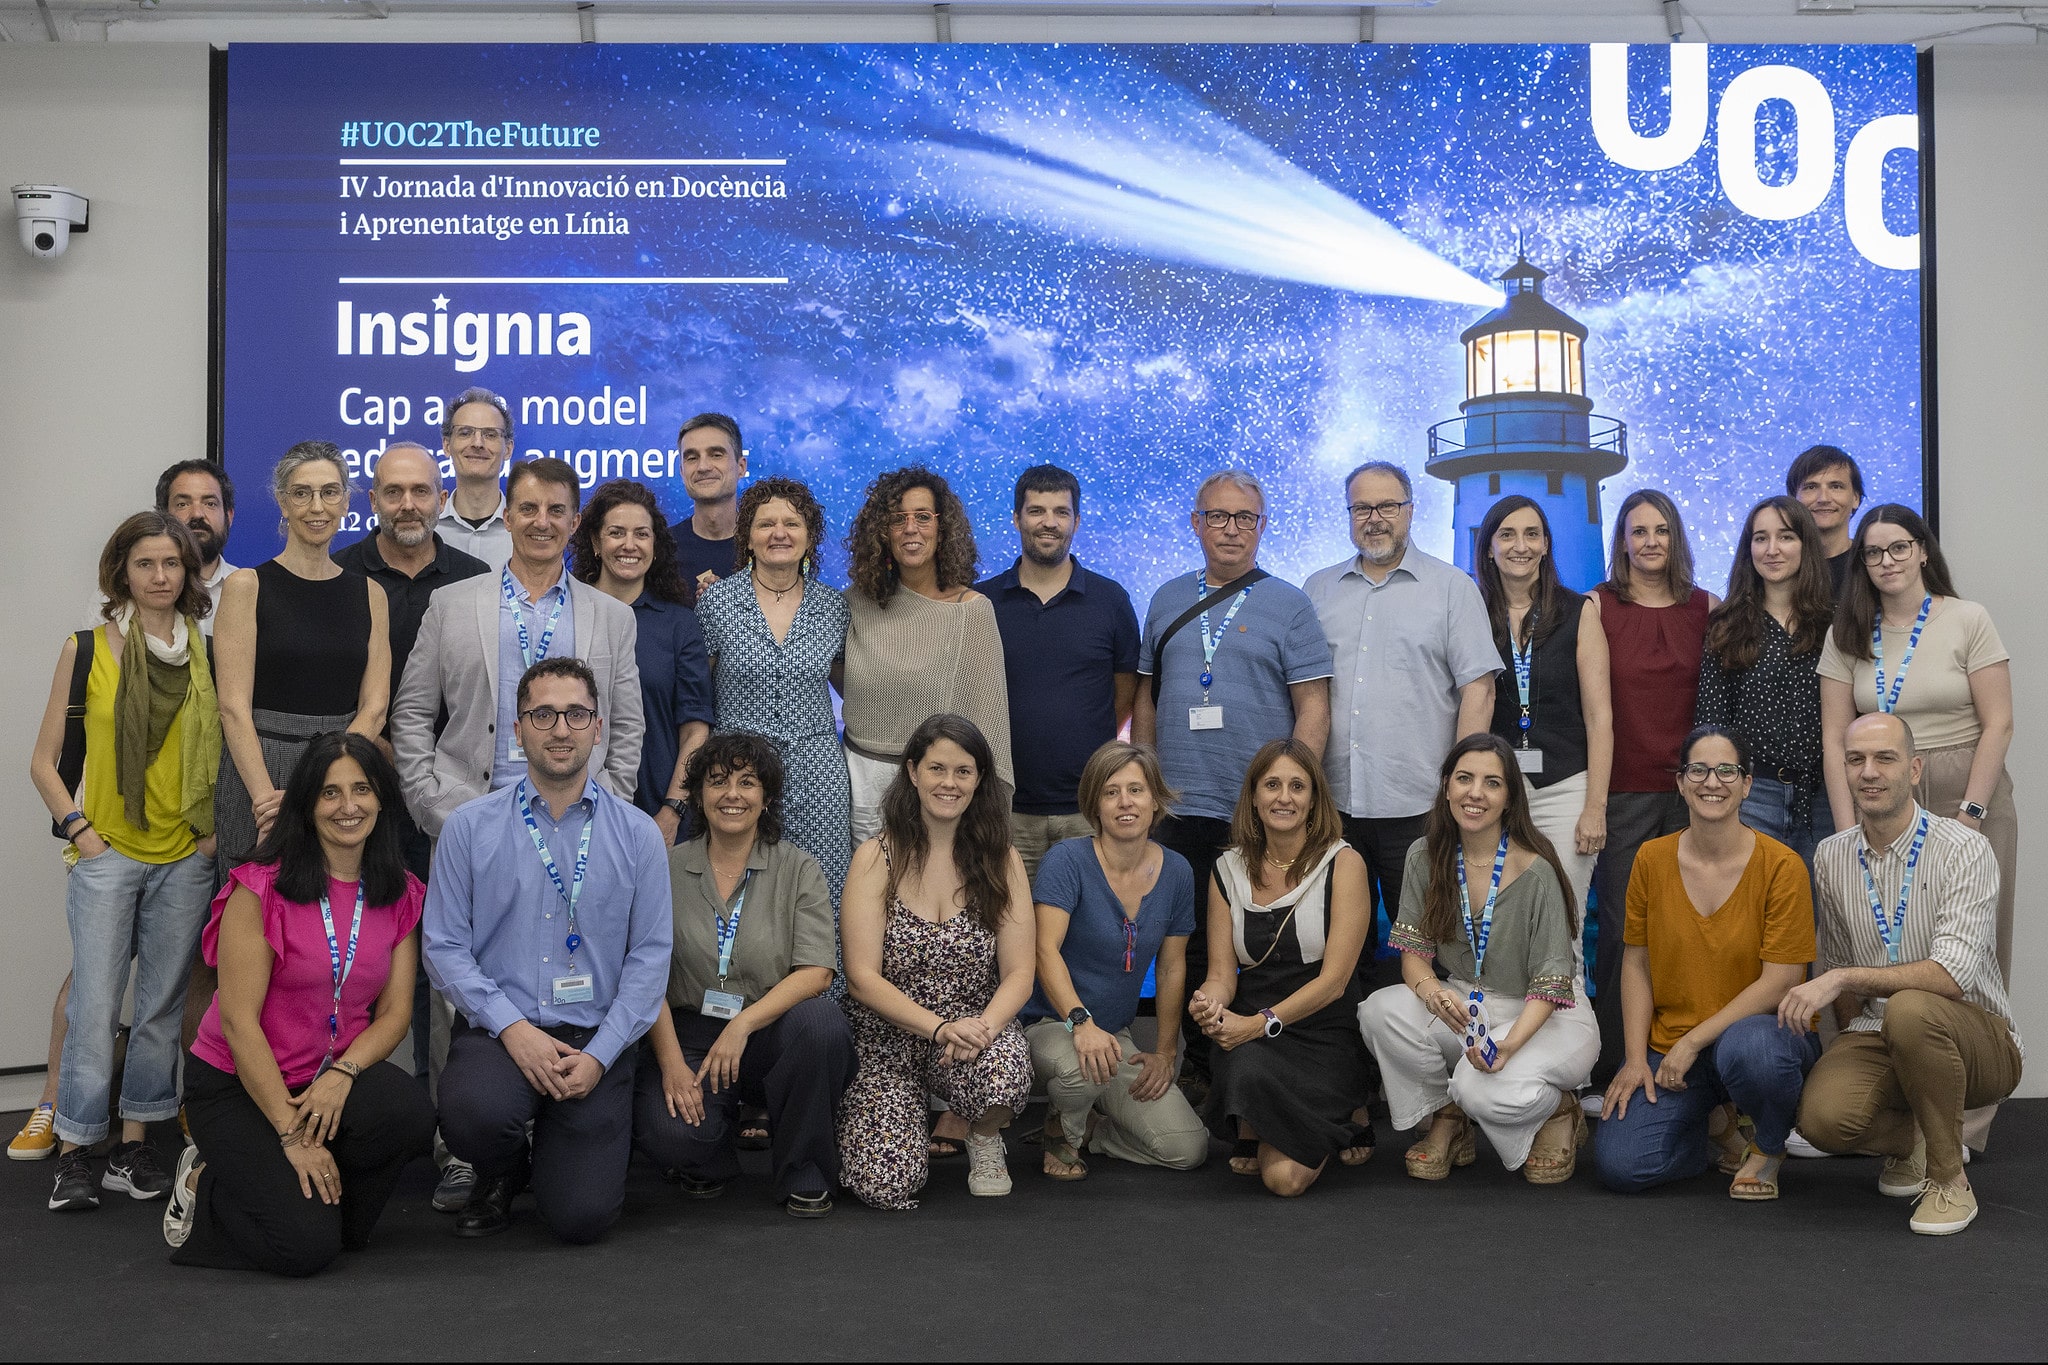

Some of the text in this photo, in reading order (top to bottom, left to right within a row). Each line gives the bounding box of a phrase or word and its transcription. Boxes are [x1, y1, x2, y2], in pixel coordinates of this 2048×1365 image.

[340, 120, 600, 148] #UOC2TheFuture
[1590, 43, 1920, 270] UOC
[340, 175, 787, 198] IV Jornada d'Innovació en Docència
[339, 211, 630, 241] i Aprenentatge en Línia
[339, 387, 411, 435] Cap
[424, 396, 444, 426] a
[522, 385, 647, 426] model
